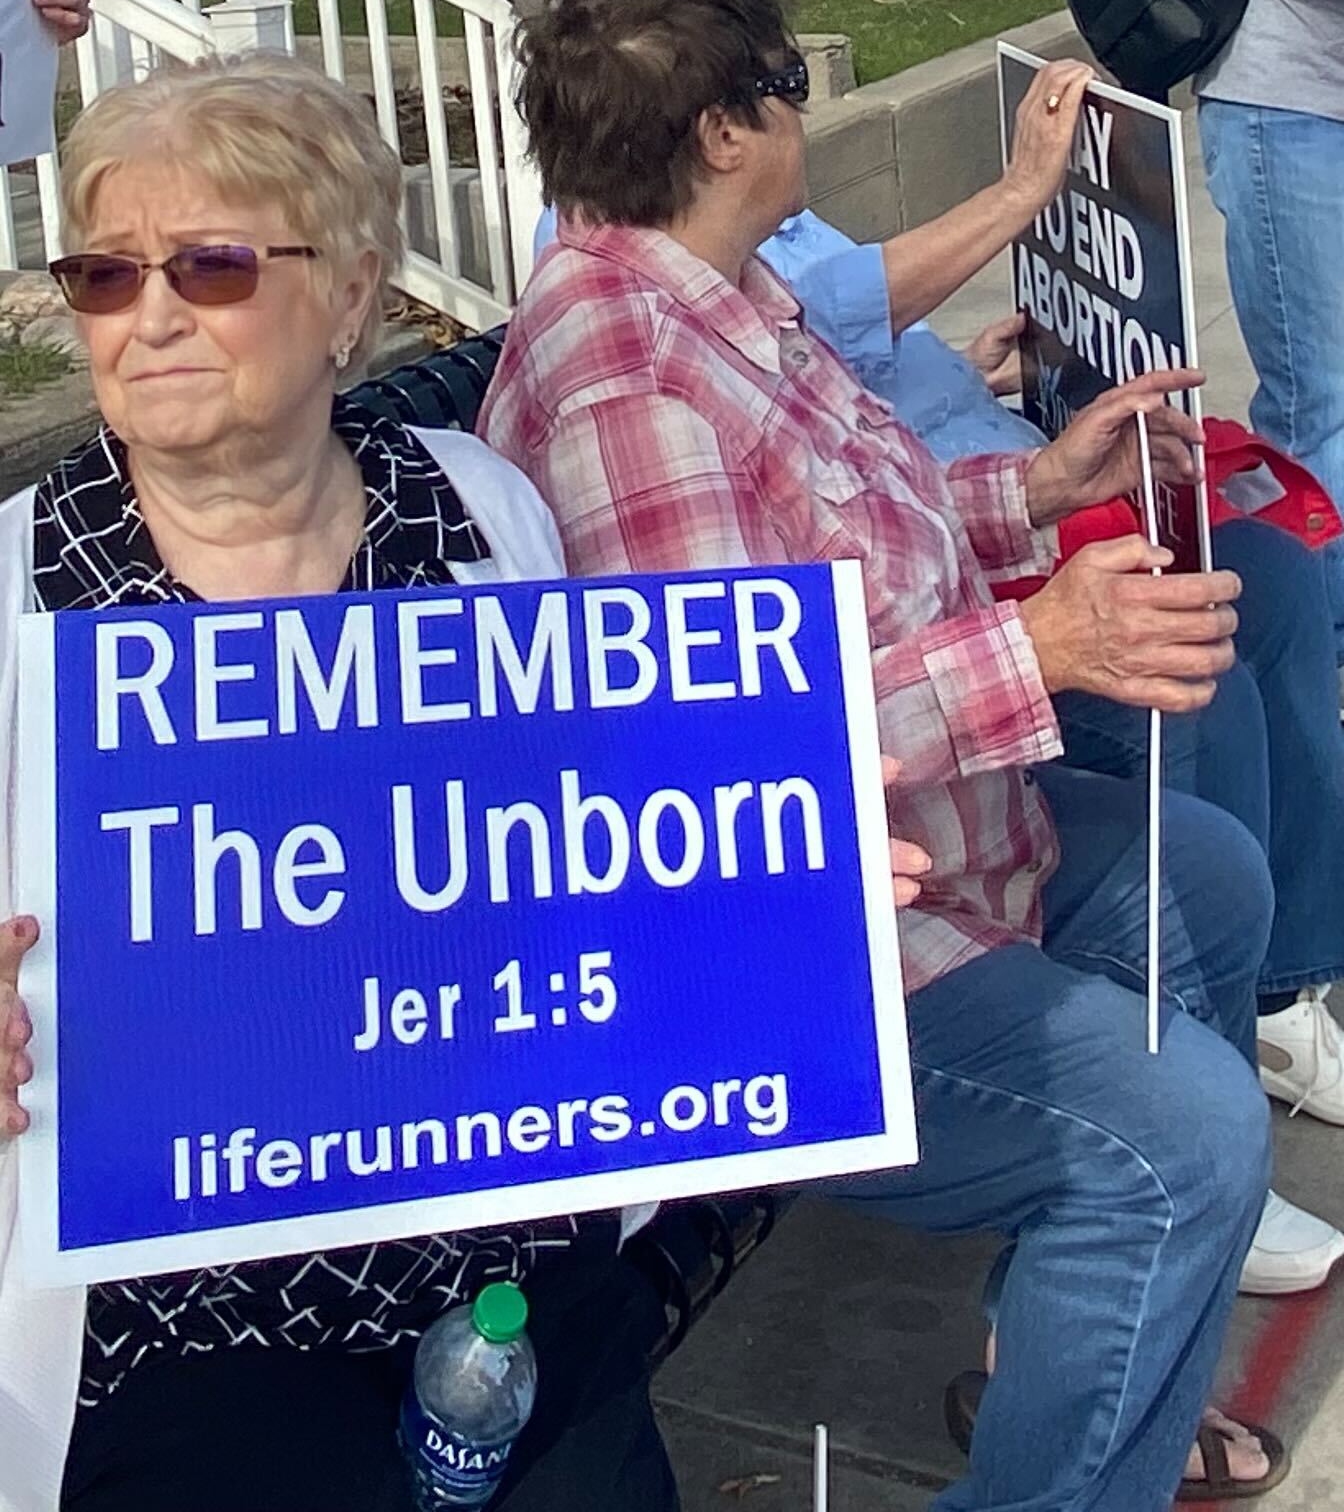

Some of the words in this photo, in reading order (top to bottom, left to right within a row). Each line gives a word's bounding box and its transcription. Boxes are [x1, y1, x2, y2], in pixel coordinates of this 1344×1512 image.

[1069, 189, 1144, 301] END
[94, 578, 811, 751] REMEMBER
[100, 803, 347, 944] The
[391, 768, 827, 914] Unborn
[354, 977, 460, 1052] Jer
[493, 952, 619, 1033] 1:5
[172, 1072, 791, 1201] liferunners.org
